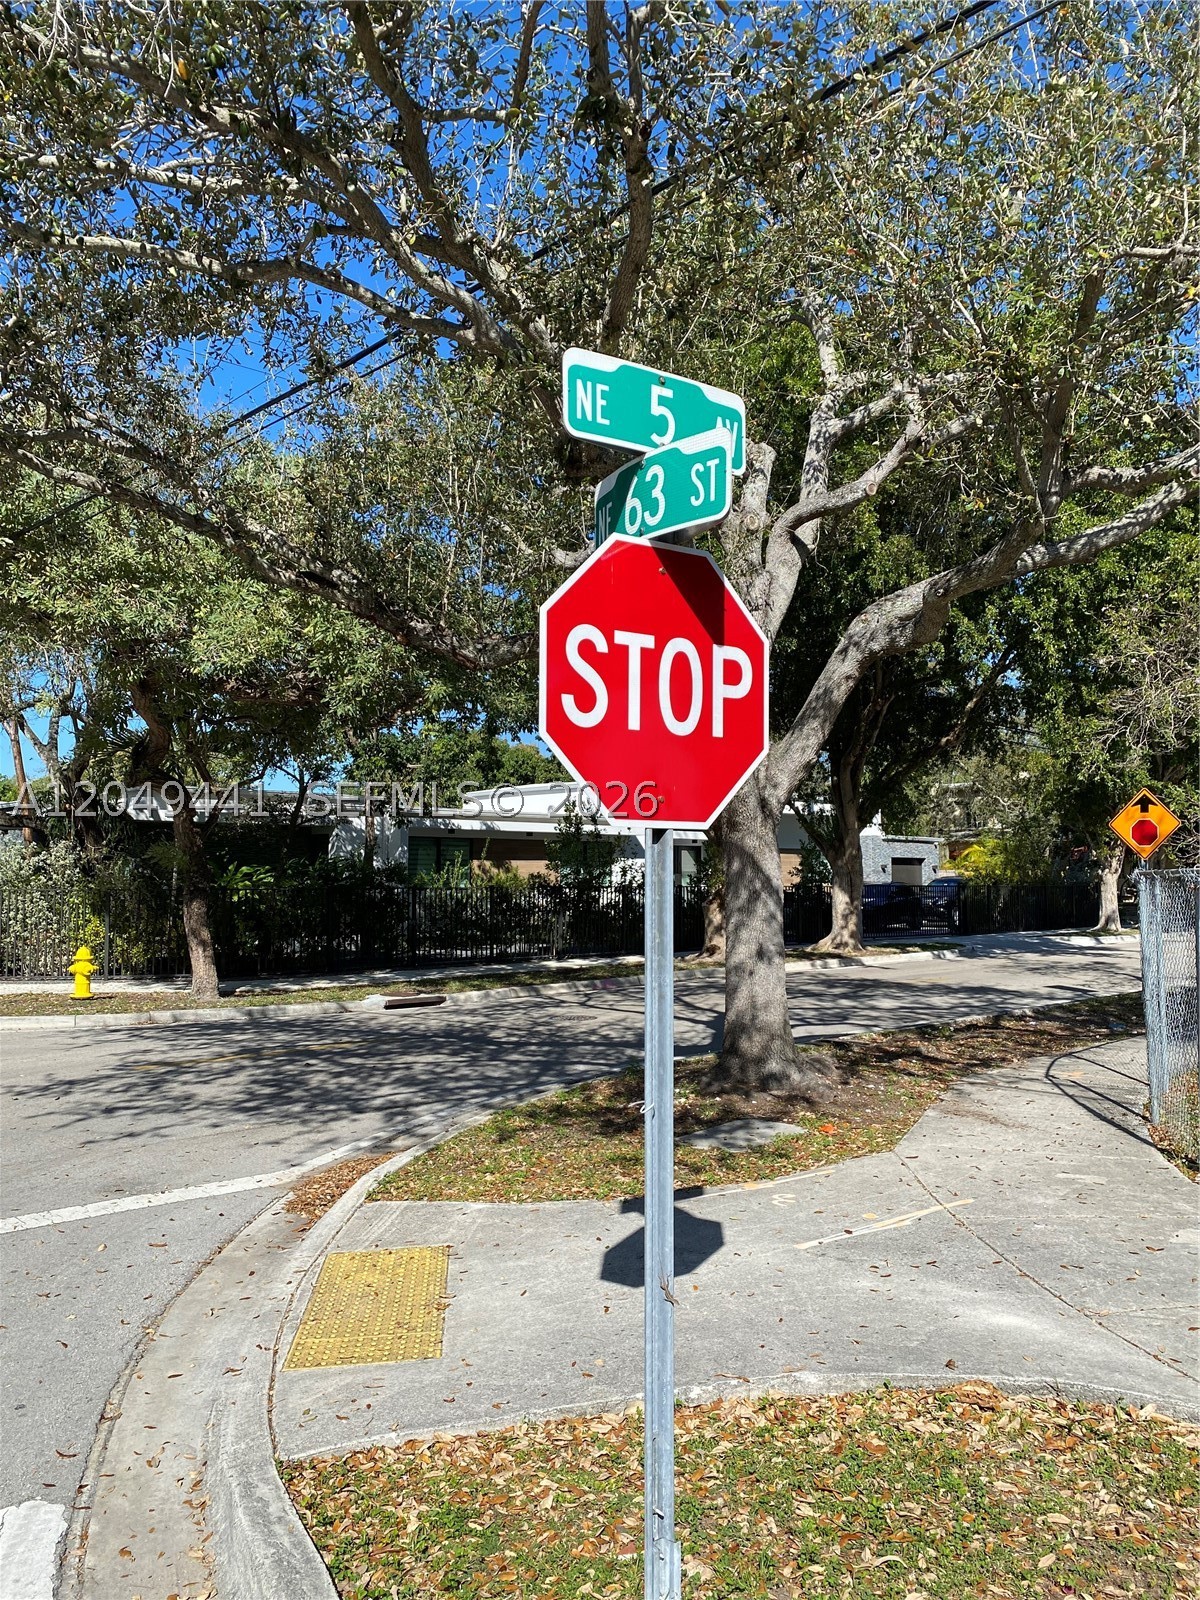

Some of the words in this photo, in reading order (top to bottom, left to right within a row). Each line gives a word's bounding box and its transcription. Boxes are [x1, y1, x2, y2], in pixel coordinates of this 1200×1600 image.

[576, 379, 610, 426] NE
[650, 384, 676, 445] 5
[624, 464, 665, 535] 63
[690, 458, 720, 507] ST
[560, 623, 753, 738] STOP
